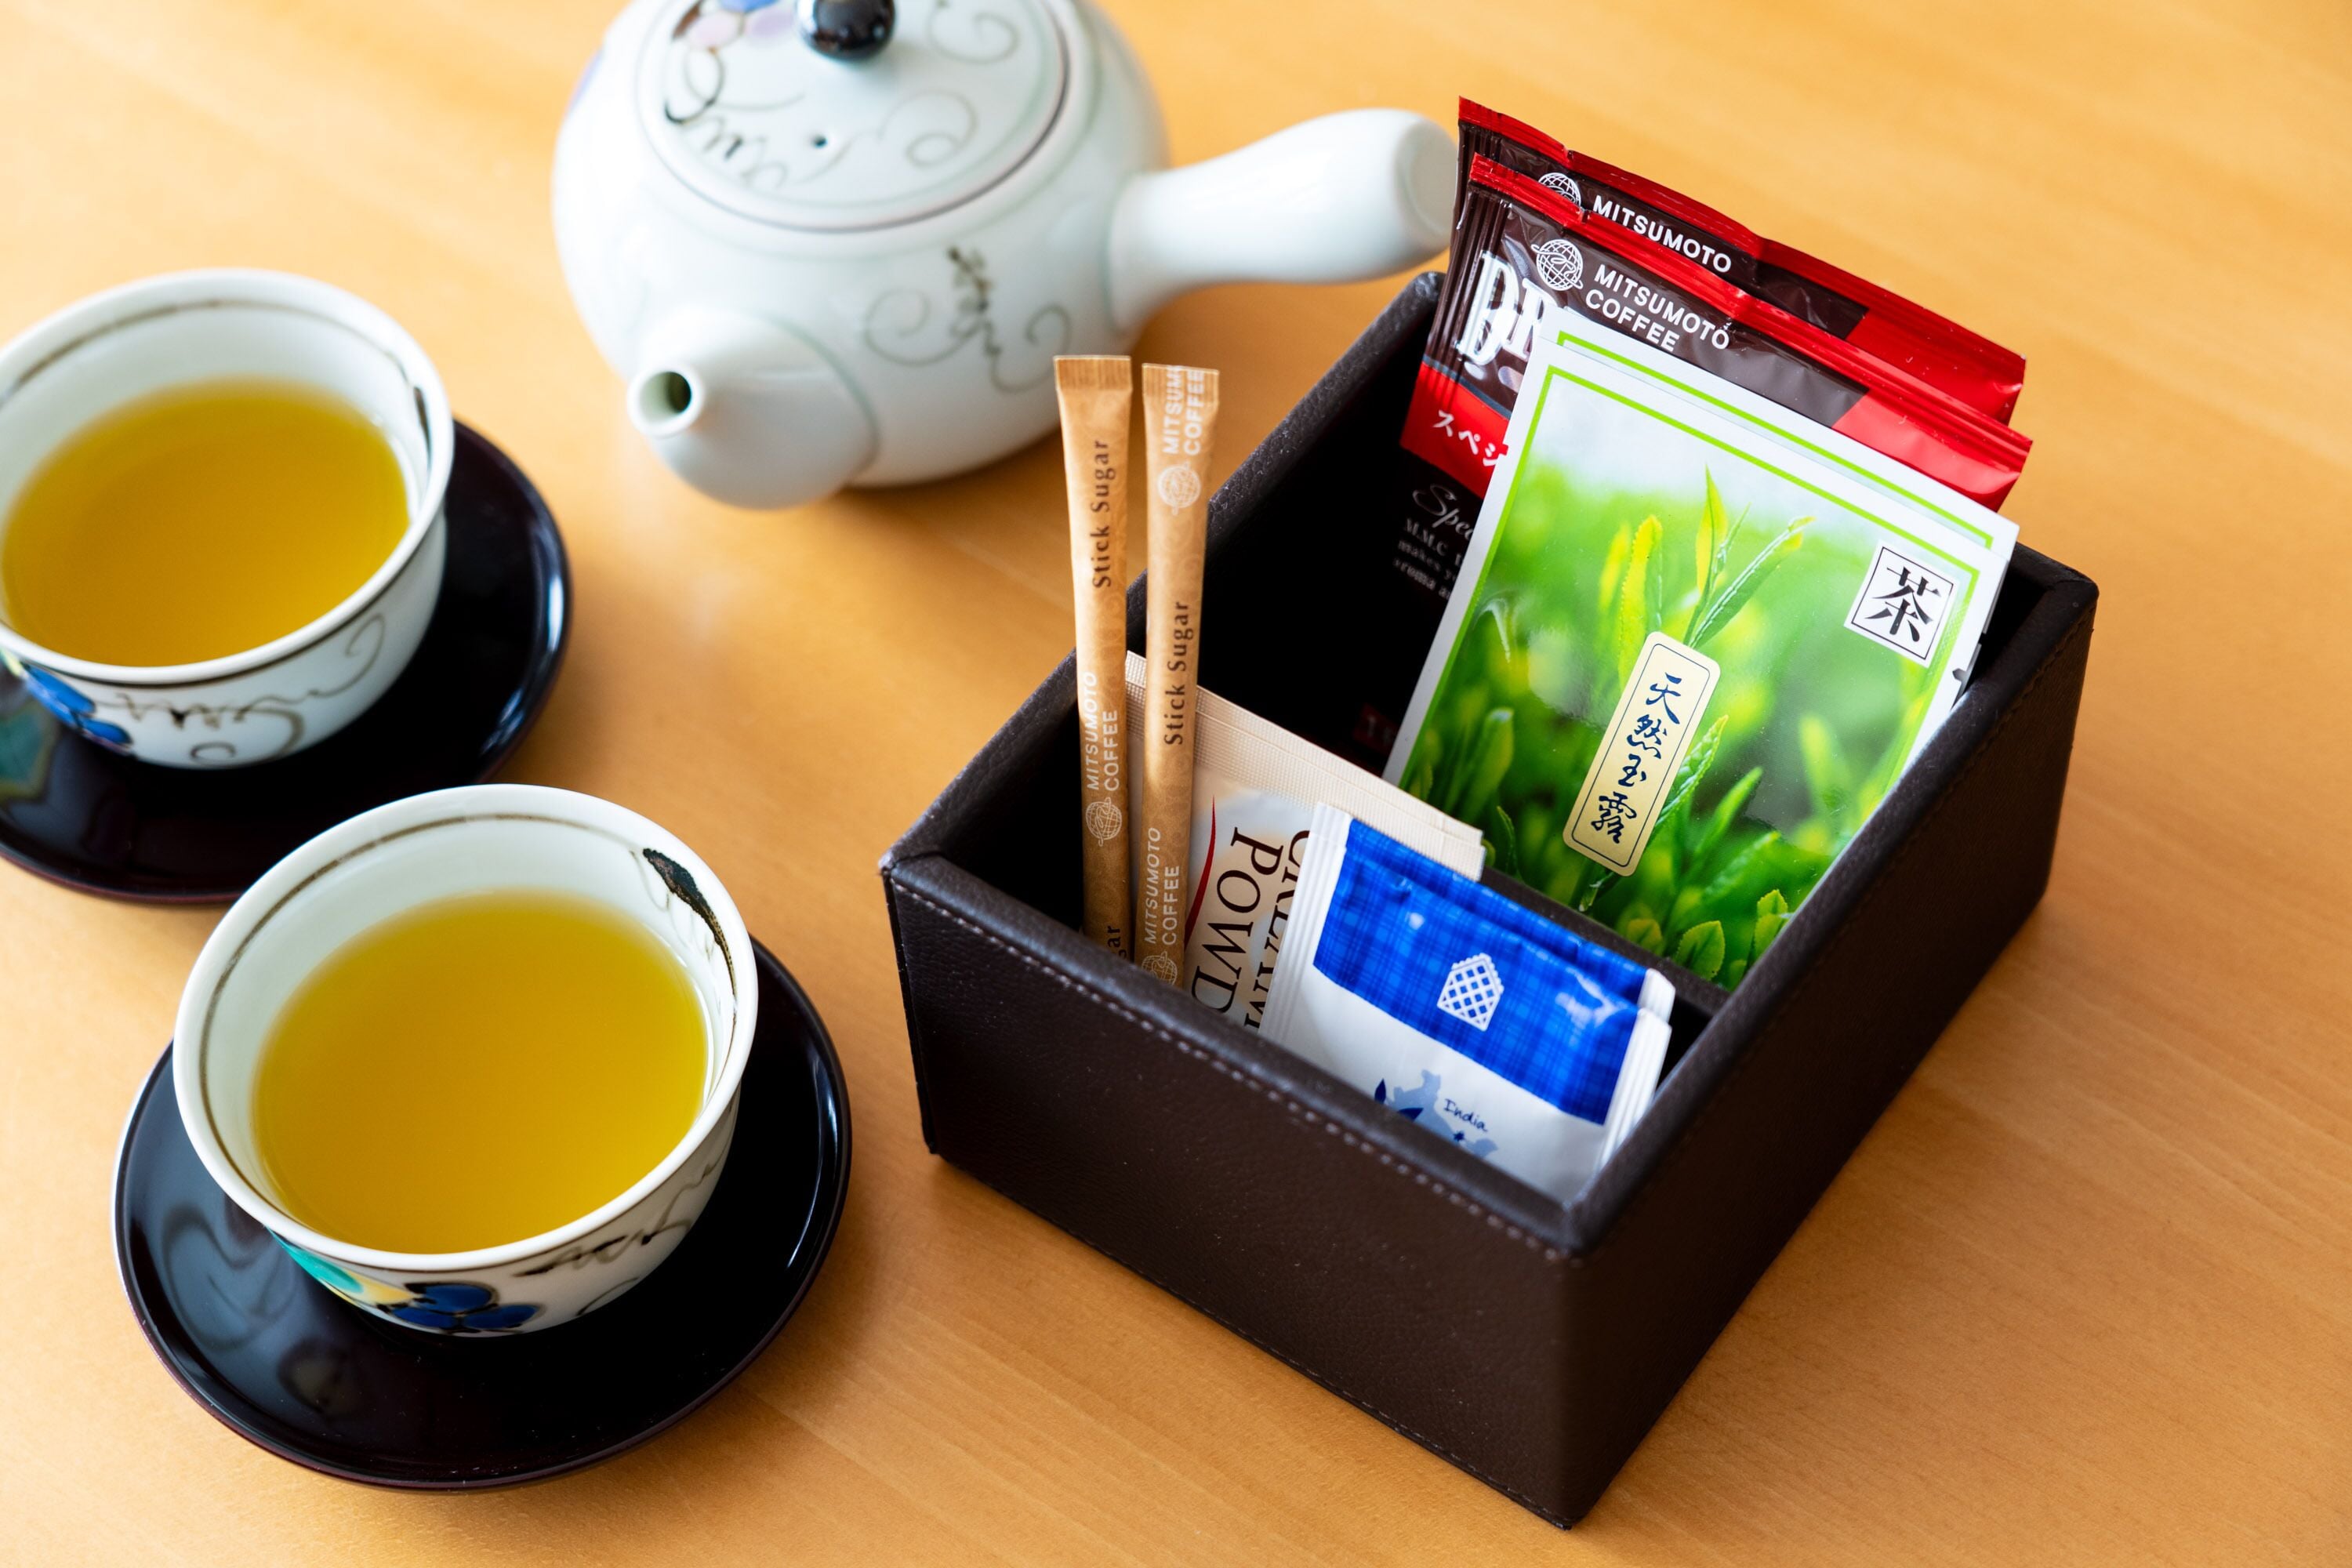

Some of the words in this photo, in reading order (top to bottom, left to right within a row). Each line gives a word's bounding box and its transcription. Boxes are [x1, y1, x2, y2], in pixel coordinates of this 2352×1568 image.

[1592, 194, 1732, 273] MITSUMOTO
[1585, 289, 1680, 352] COFFEE
[1593, 263, 1730, 350] MITSUMOTO
[1183, 369, 1205, 456] COFFEE
[1090, 441, 1116, 514] Sugar
[1090, 525, 1112, 589] Stick
[1167, 601, 1193, 672] Sugar
[1864, 565, 1942, 644] 茶
[1084, 672, 1099, 790] MITSUMOTO
[1102, 710, 1120, 792] COFFEE
[1163, 684, 1185, 745] Stick
[1590, 671, 1683, 844] 天然玉露
[1144, 827, 1162, 945] MITSUMOTO
[1162, 865, 1180, 946] COFFEE
[1443, 1098, 1488, 1132] India
